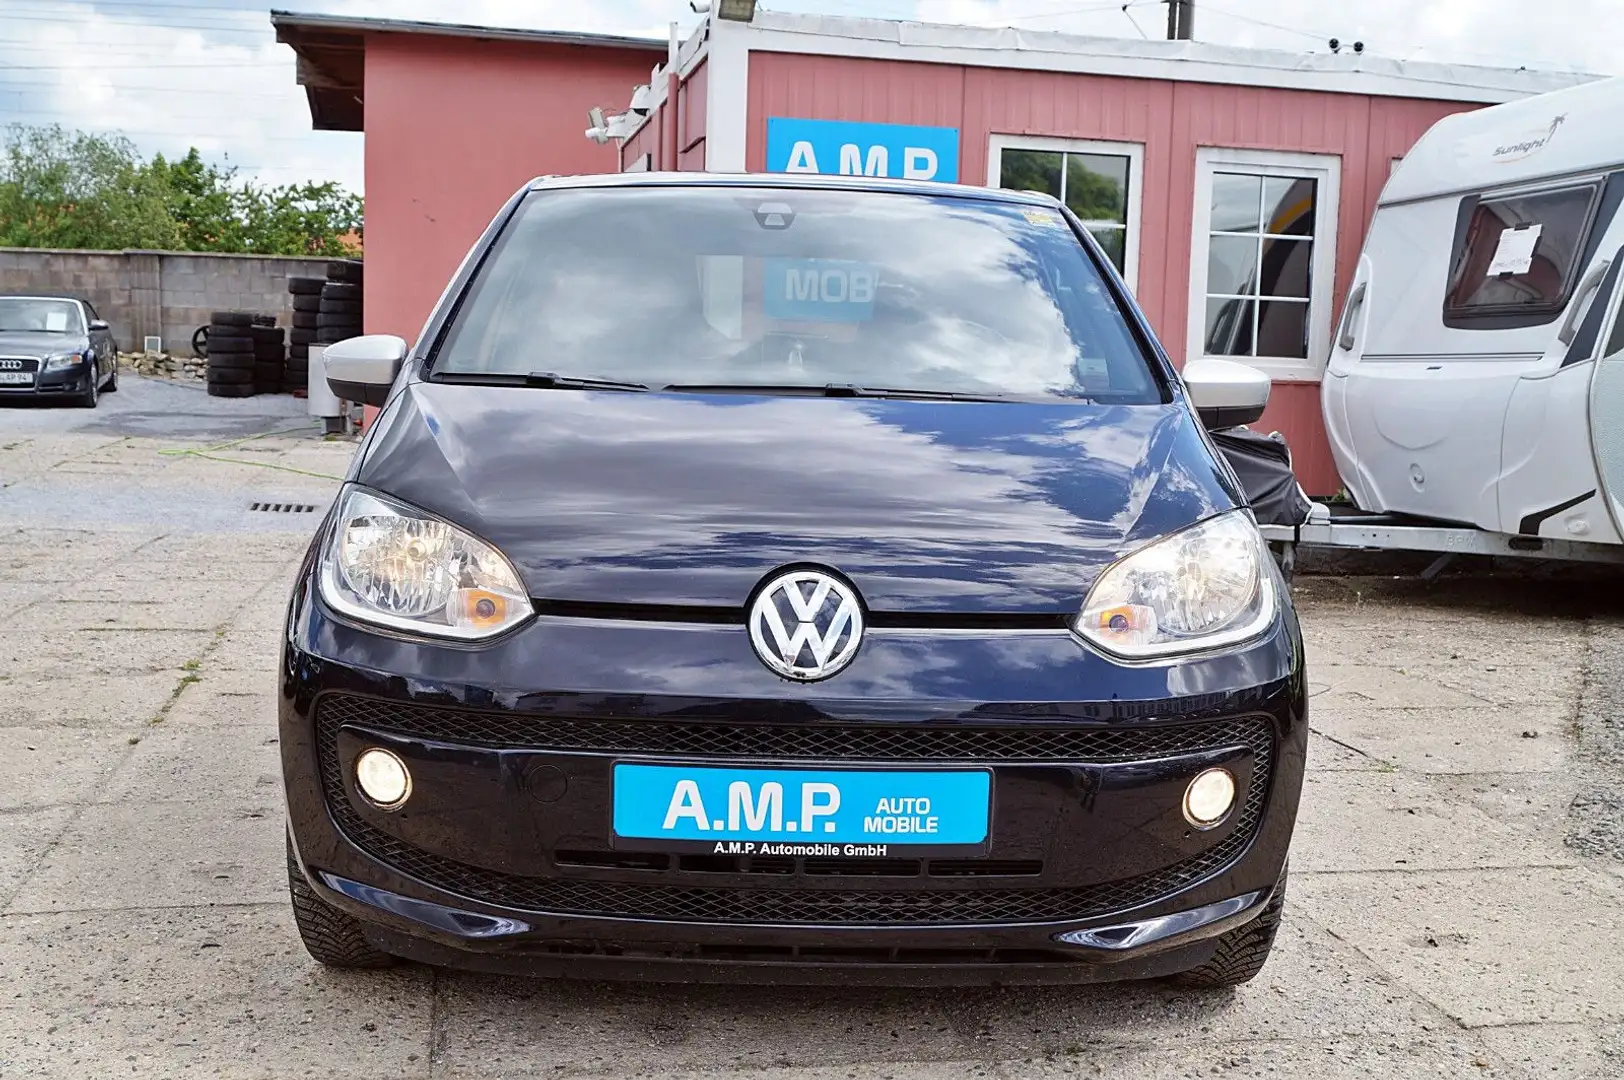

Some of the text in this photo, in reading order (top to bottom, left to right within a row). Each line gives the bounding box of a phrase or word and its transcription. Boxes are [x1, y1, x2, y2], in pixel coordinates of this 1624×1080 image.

[1492, 138, 1546, 156] Sunlight
[661, 779, 841, 834] A.M.P.
[875, 797, 931, 815] AUTO
[863, 815, 939, 834] MOBILE
[713, 842, 888, 857] A.M.P. Automobile GmbH
